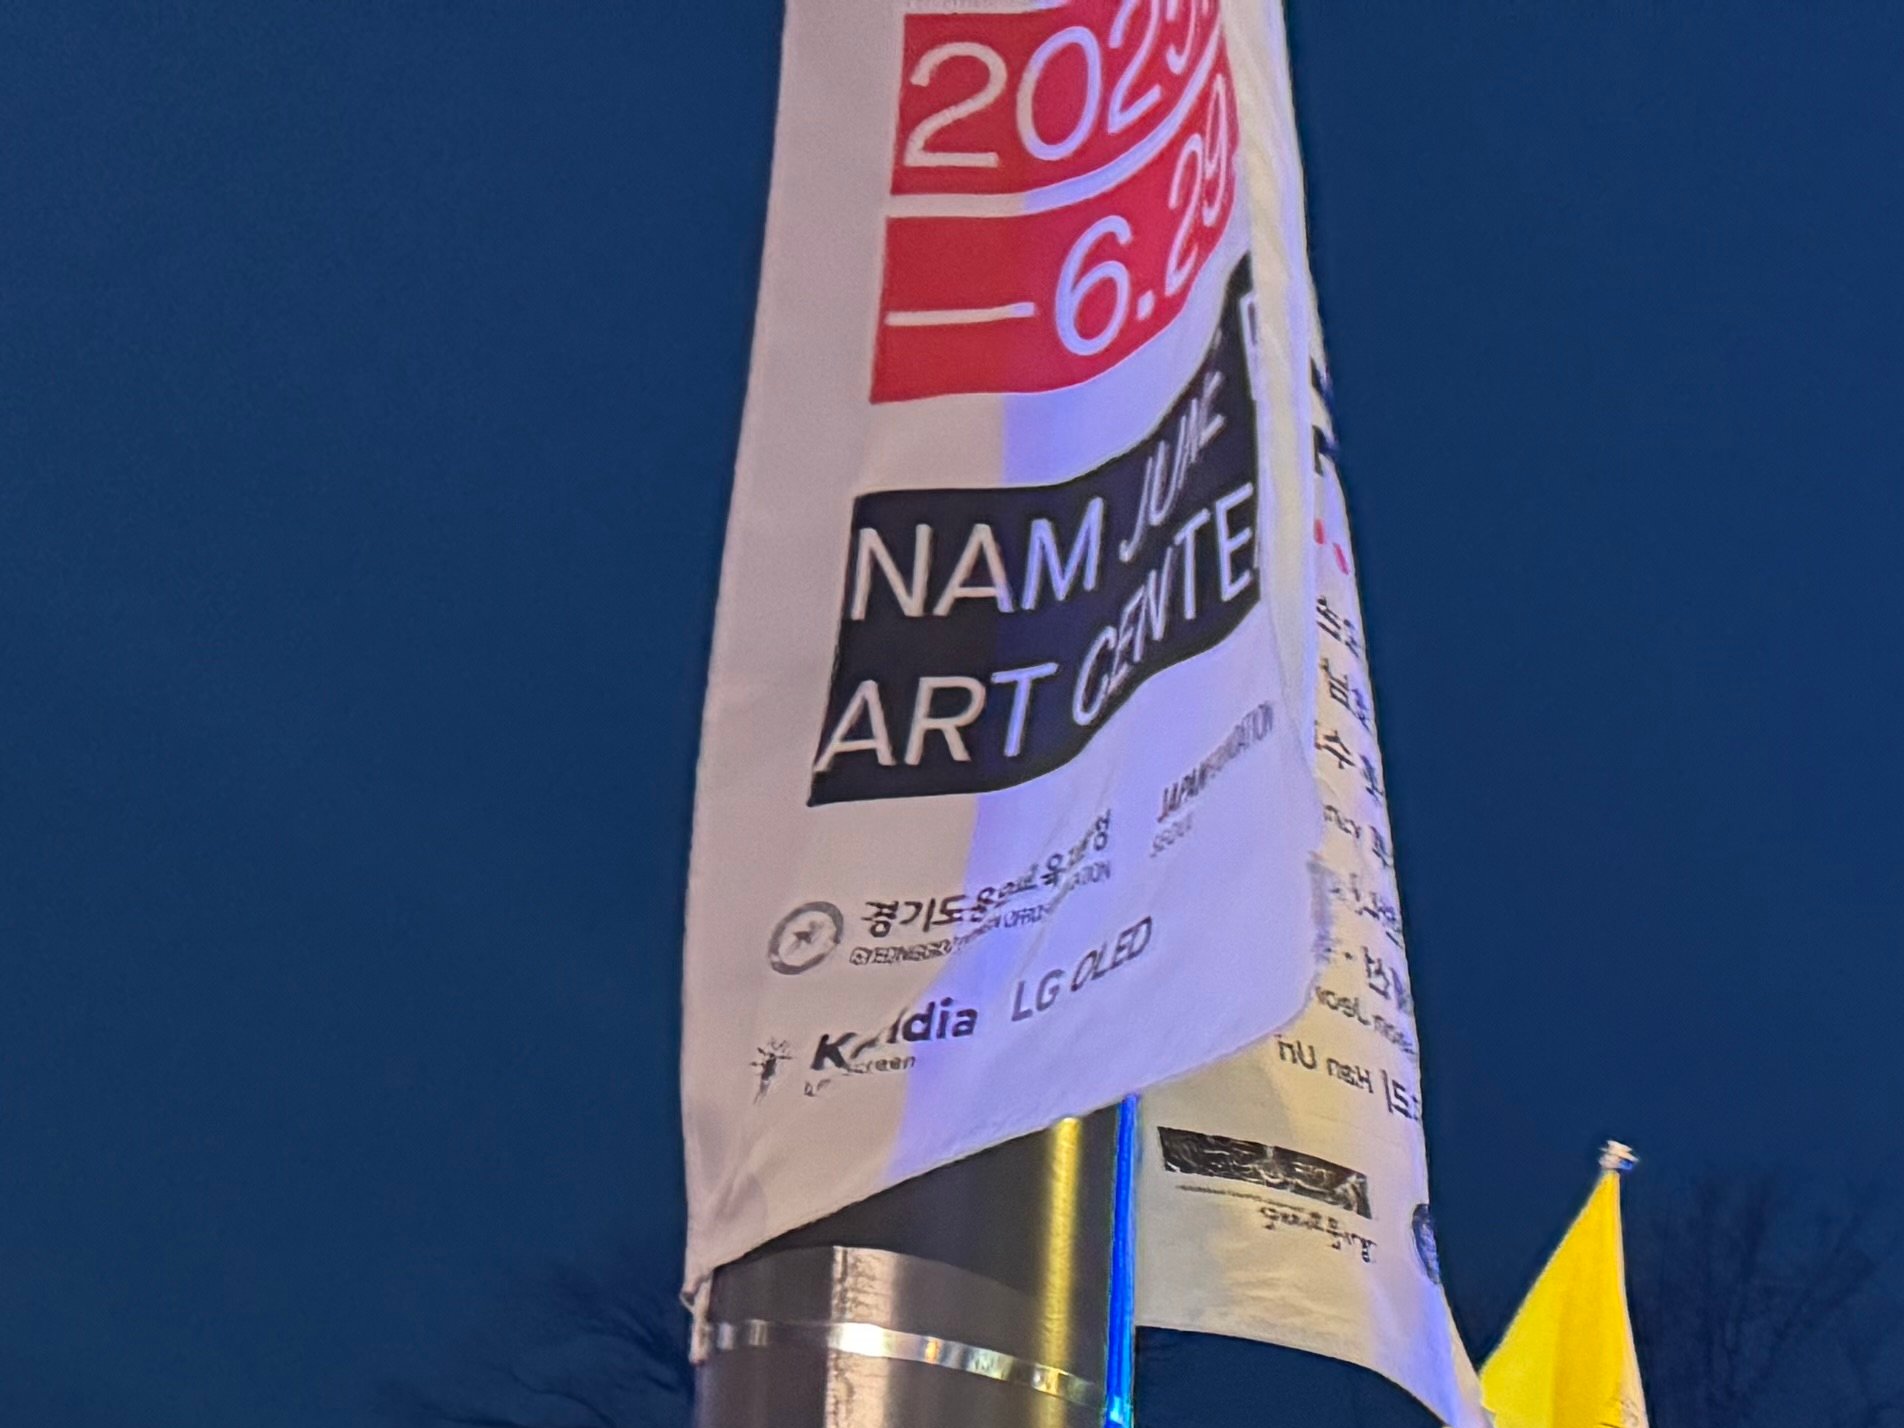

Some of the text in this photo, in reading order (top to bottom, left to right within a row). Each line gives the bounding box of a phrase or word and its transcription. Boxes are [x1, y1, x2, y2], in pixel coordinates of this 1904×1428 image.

[850, 497, 1104, 620] NAM
[814, 481, 1259, 771] ART CENTE
[1011, 969, 1064, 1022] LG
[1071, 917, 1152, 992] OLED
